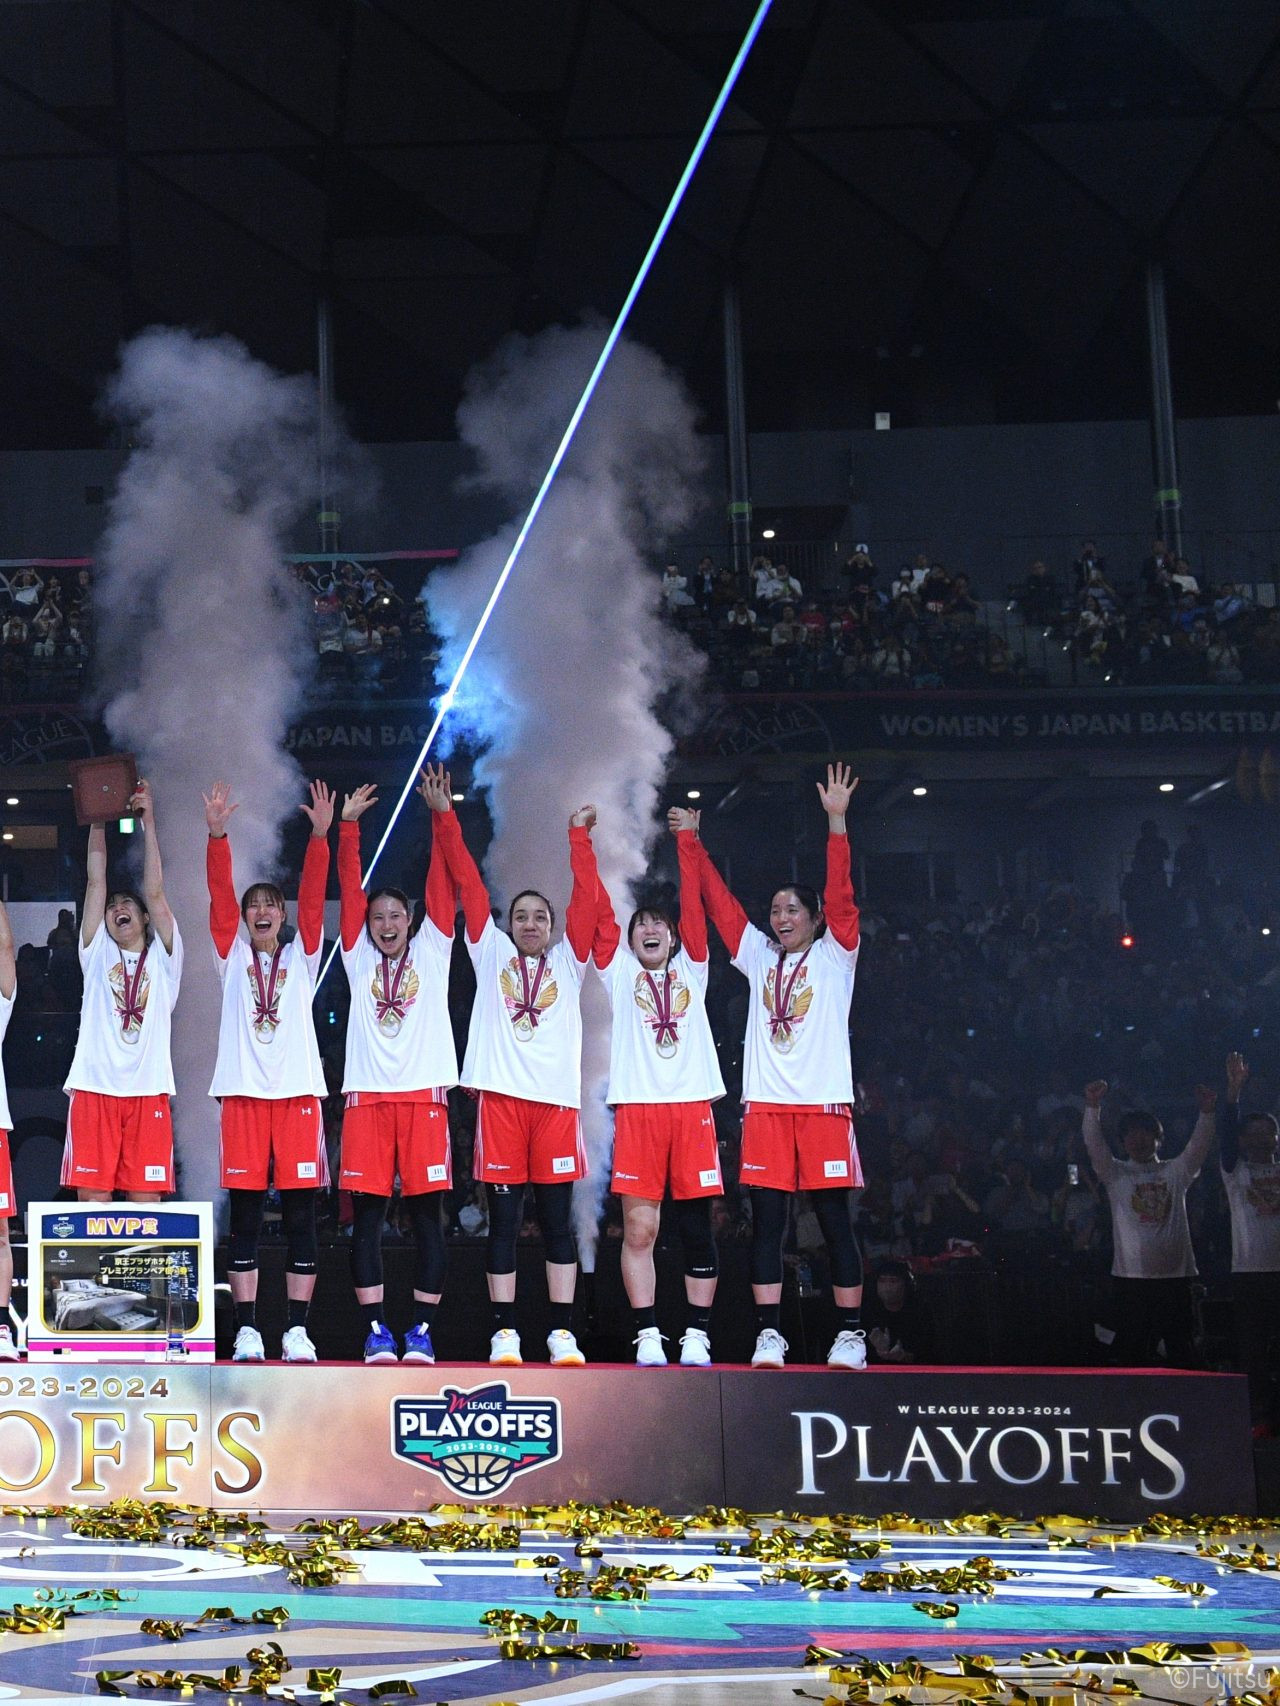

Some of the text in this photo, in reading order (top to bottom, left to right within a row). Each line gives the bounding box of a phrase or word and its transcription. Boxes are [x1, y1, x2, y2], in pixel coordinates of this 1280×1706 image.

[880, 714, 1029, 738] WOMEN'S
[1038, 713, 1132, 736] JAPAN
[282, 726, 370, 750] JAPAN
[467, 1401, 503, 1411] LEAGUE
[898, 1405, 1072, 1416] W LEAGUE 2023-2024
[399, 1412, 553, 1439] PLAYOFFS
[446, 1442, 507, 1454] 2023-2024
[791, 1411, 1187, 1501] PLAYOFFS
